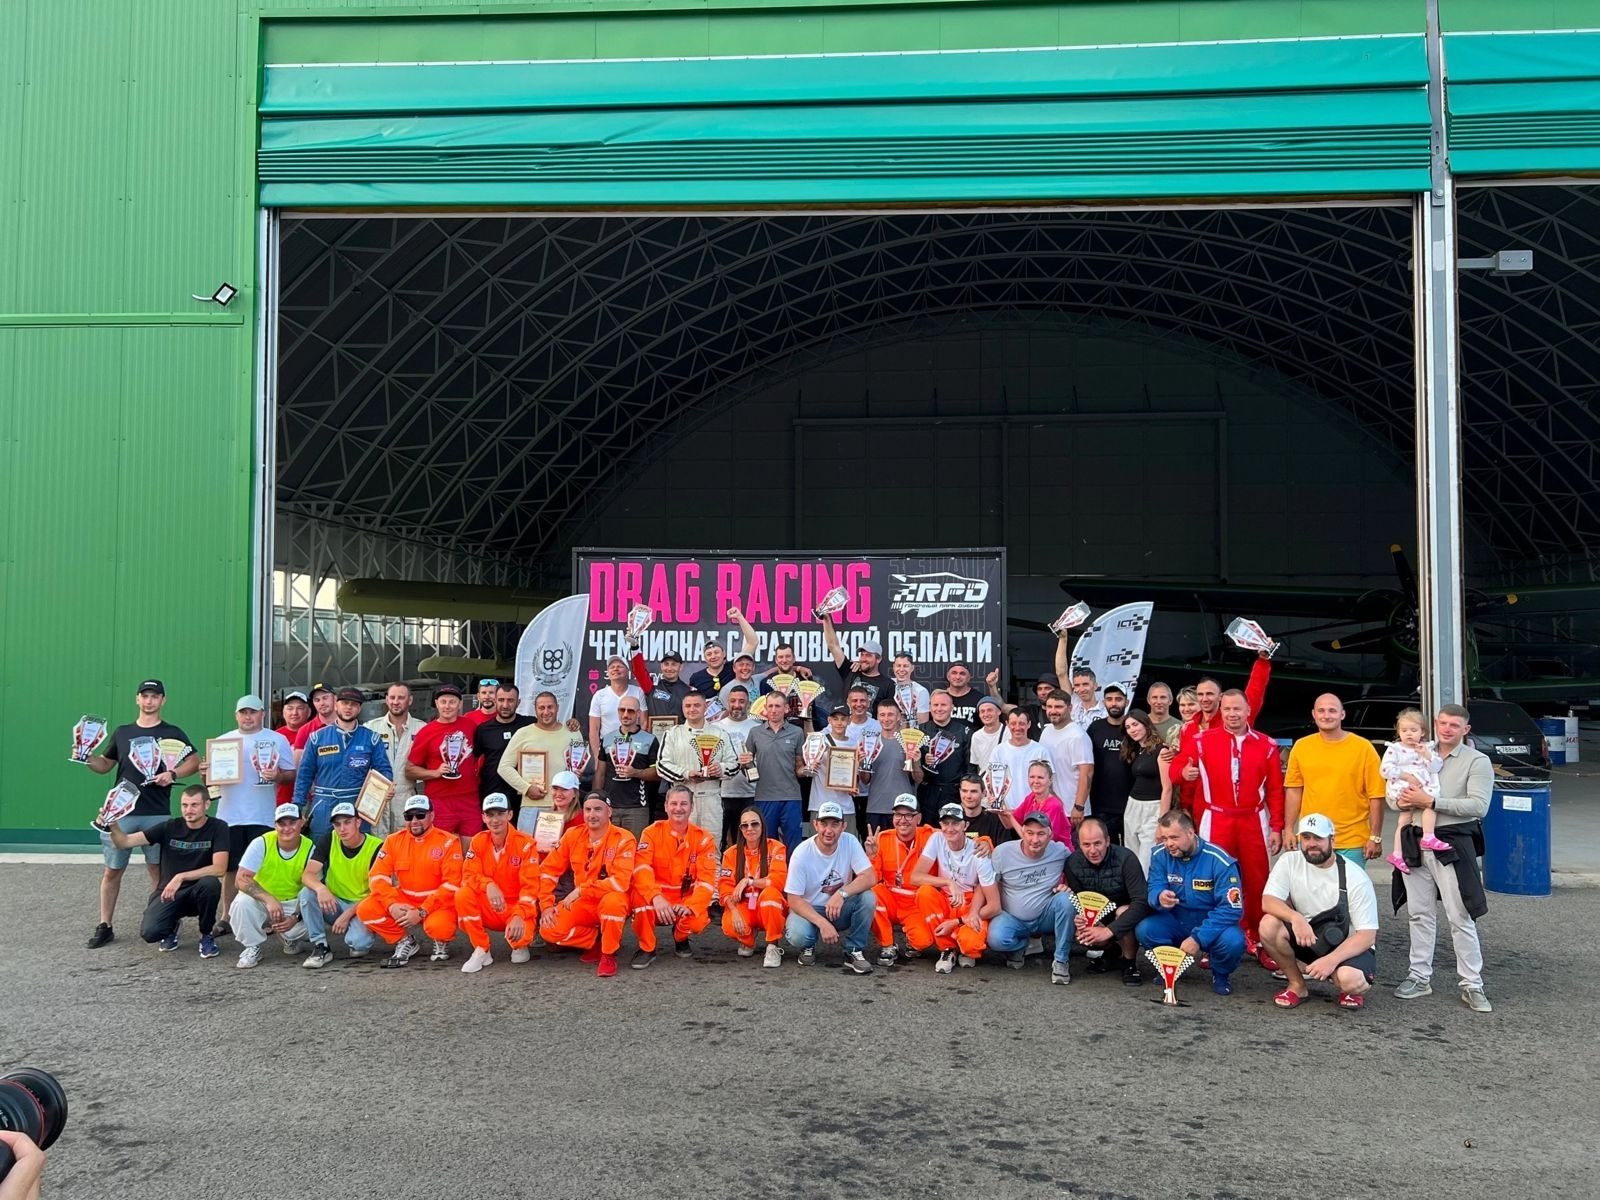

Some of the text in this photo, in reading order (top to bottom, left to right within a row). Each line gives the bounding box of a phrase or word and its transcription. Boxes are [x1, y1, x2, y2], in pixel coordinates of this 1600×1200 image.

[589, 562, 701, 624] DRAG
[716, 562, 871, 625] RACING
[726, 625, 880, 662] СРАТОВСКОЙ
[888, 630, 992, 663] ОБЛАСТИ
